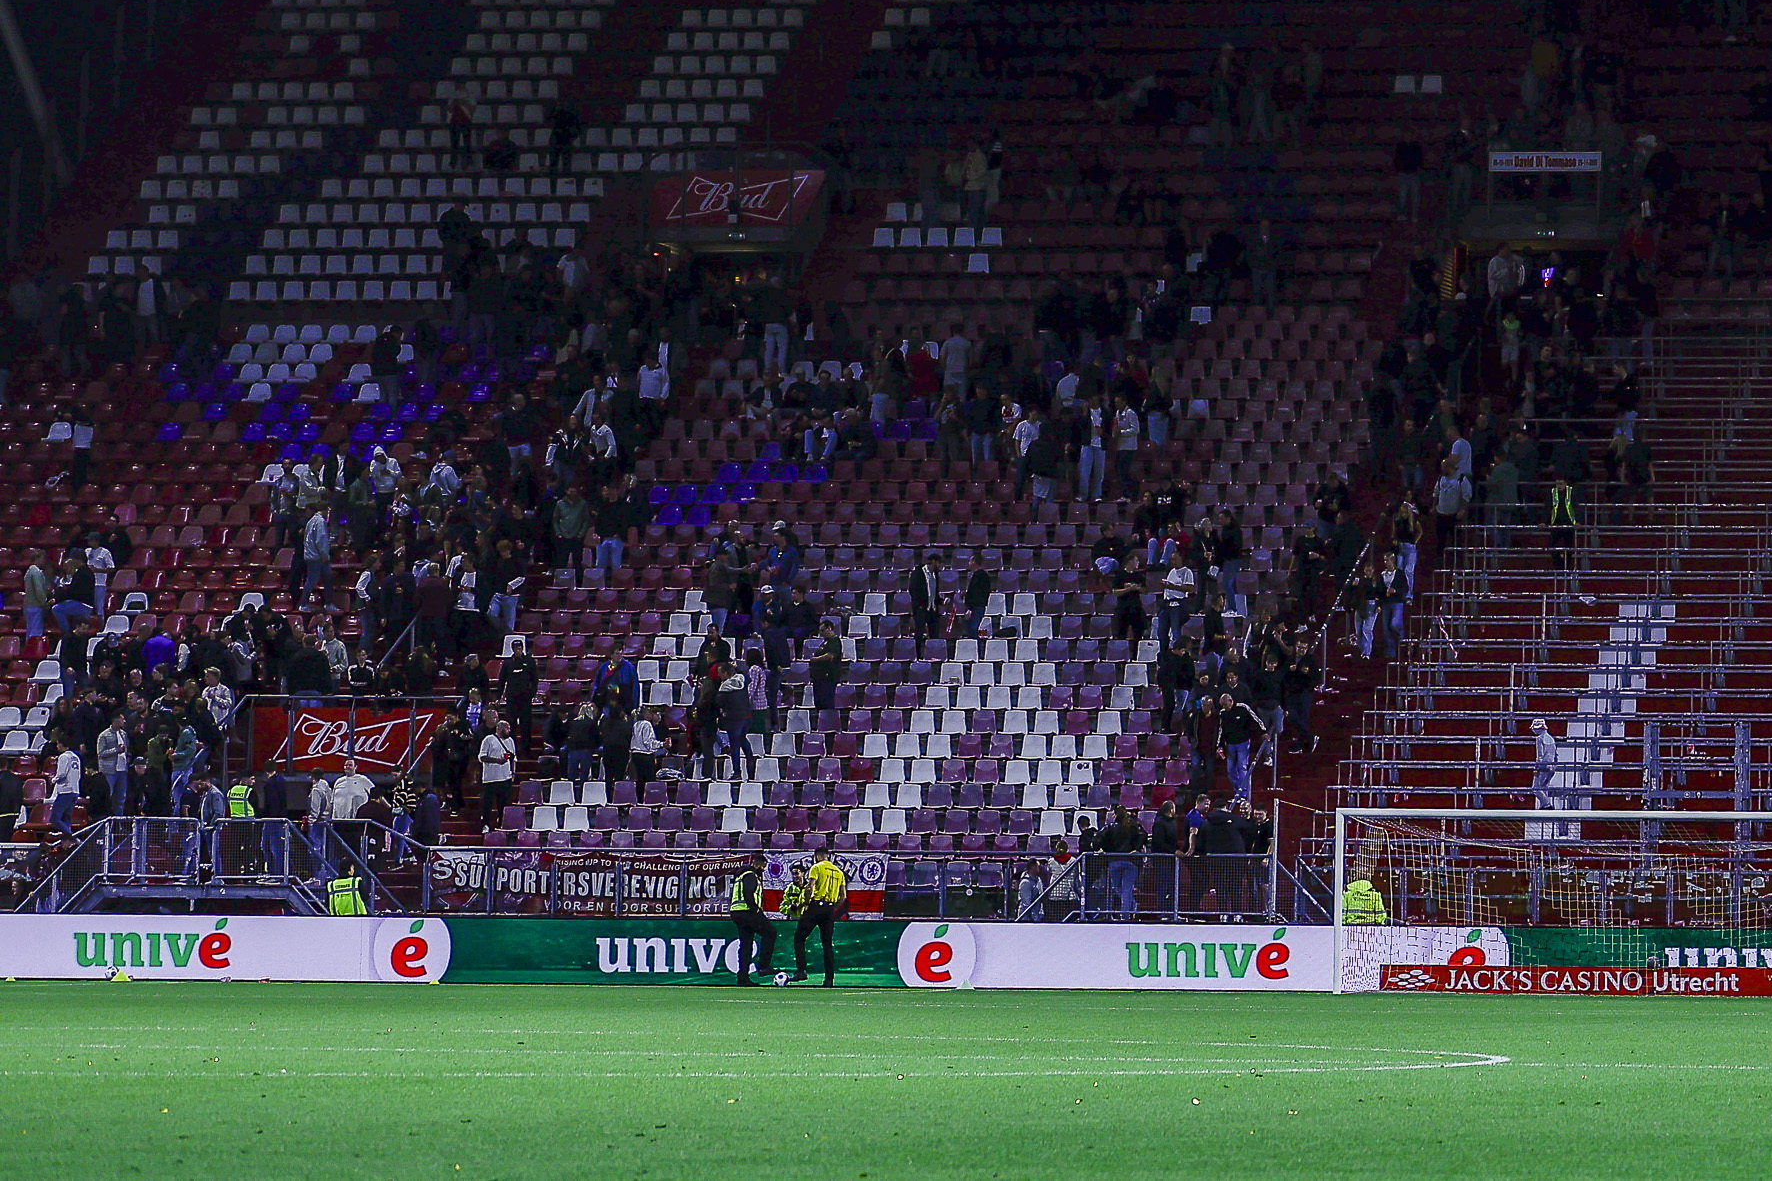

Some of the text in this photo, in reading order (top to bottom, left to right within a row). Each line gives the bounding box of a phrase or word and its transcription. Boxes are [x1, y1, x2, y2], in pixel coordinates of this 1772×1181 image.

[693, 181, 771, 212] Bud
[301, 720, 392, 755] Bud
[634, 861, 681, 871] CHALLENG
[74, 918, 232, 970] univé
[1125, 927, 1290, 981] univé
[1444, 969, 1740, 993] JACK'S CASINO Utrecht
